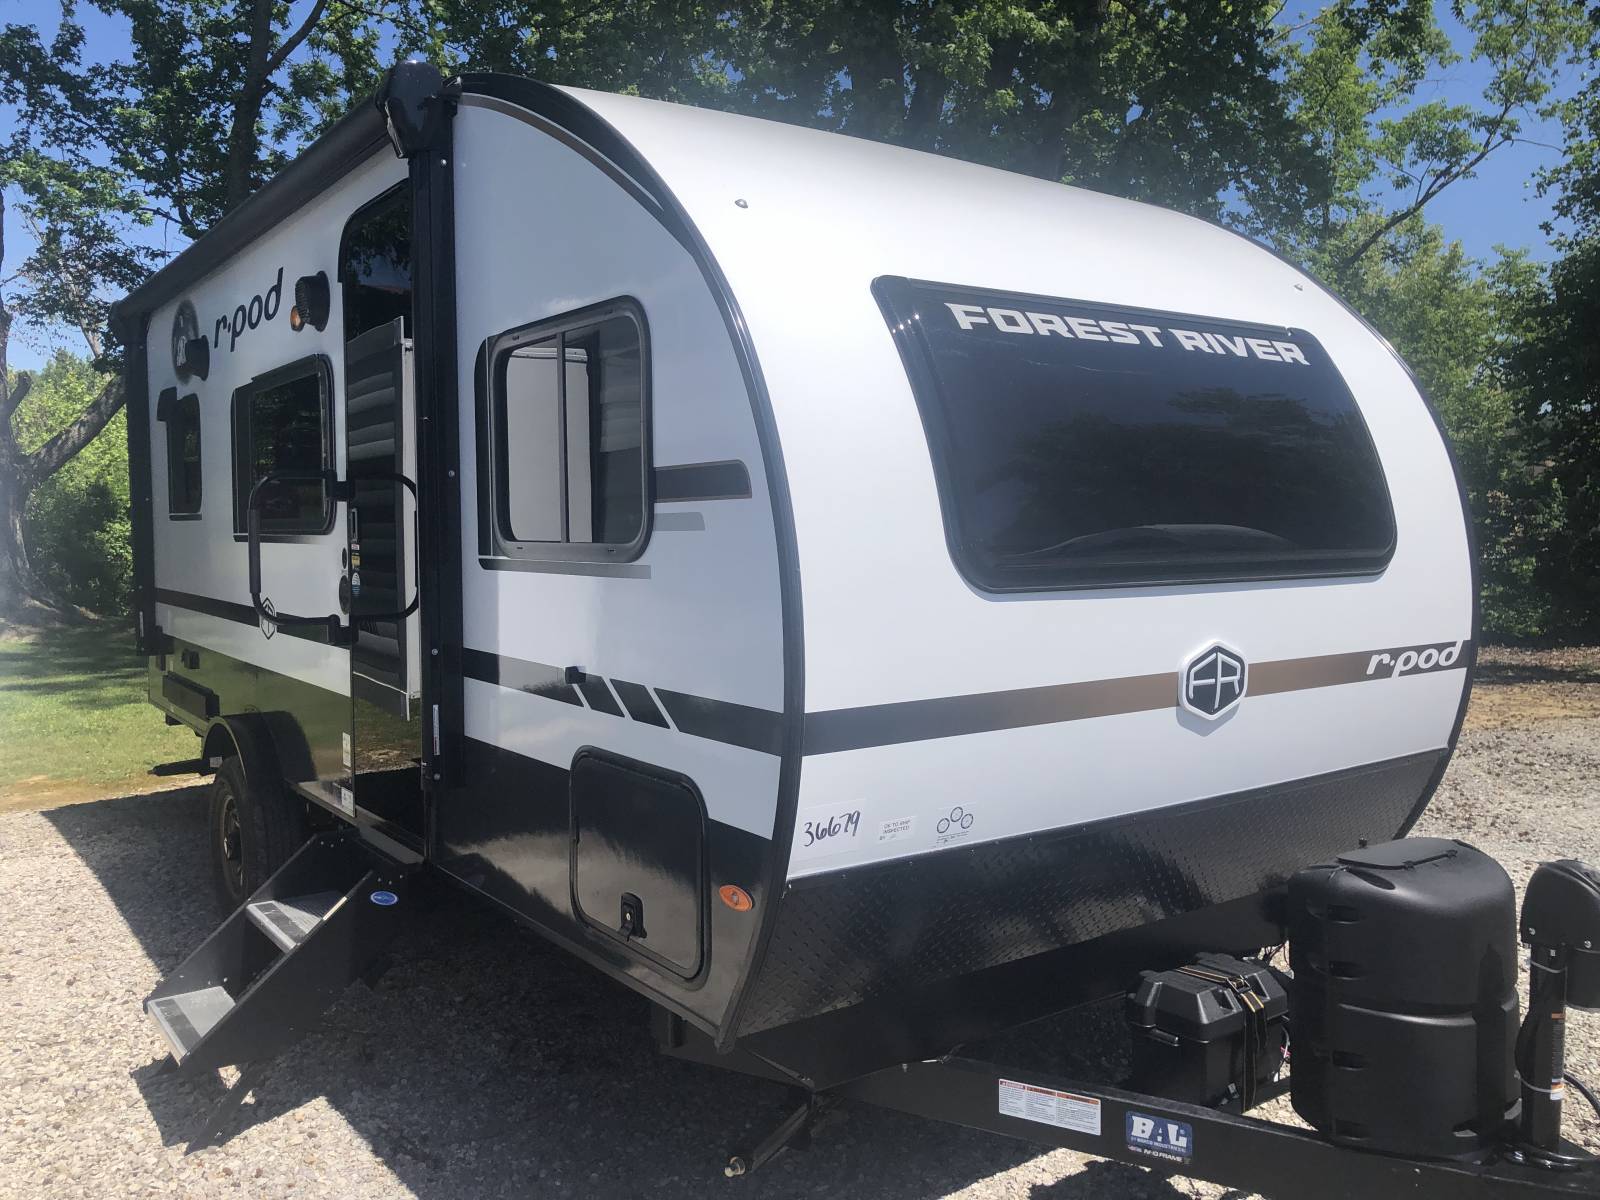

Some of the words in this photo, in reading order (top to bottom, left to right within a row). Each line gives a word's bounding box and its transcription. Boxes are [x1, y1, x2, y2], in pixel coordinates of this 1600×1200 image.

[944, 302, 1164, 348] FOREST
[1167, 328, 1311, 366] RIVER
[803, 810, 861, 847] 36679
[1131, 1115, 1188, 1148] BAL
